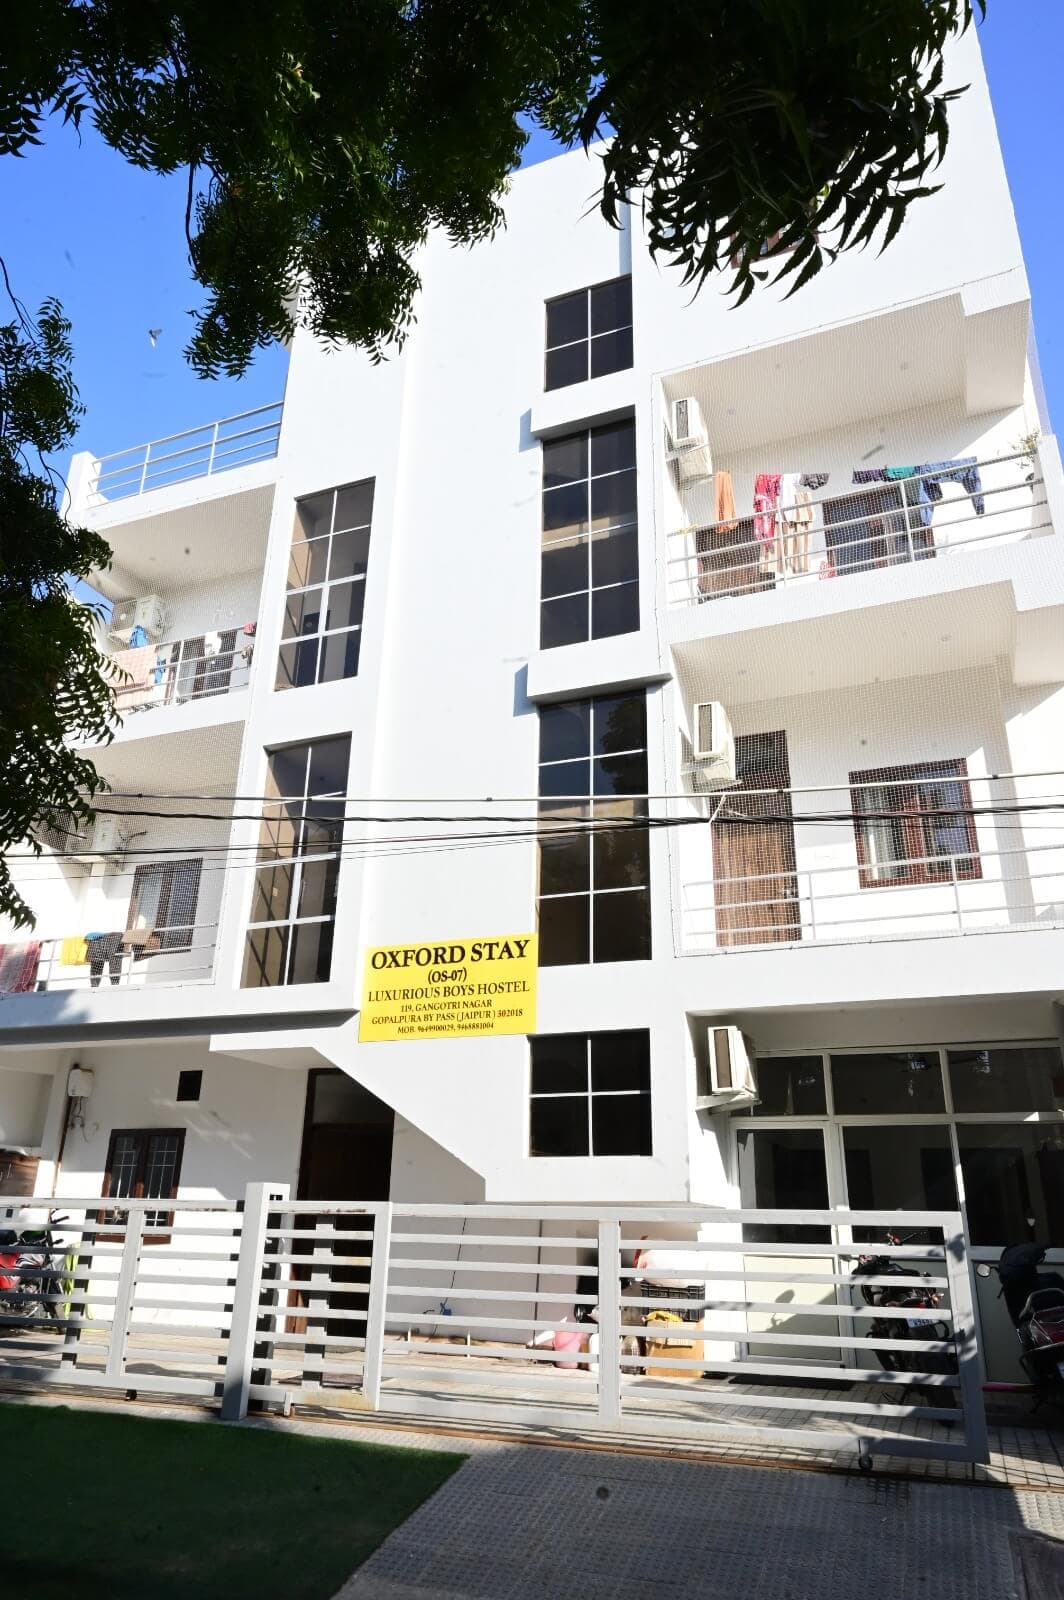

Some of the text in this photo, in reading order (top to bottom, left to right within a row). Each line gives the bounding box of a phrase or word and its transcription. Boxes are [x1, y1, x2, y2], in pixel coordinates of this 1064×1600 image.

[371, 939, 531, 970] OXFORD STAY
[428, 966, 467, 985] (OS-07)
[368, 980, 530, 1002] LUXURIOUS BOYS HOSTEL
[415, 1001, 460, 1012] GANGOTRI
[462, 999, 493, 1009] NAGAR
[371, 1013, 422, 1025] GOPALPURA
[423, 1013, 434, 1022] BY
[436, 1011, 456, 1022] PASS
[497, 1008, 523, 1018] 302018
